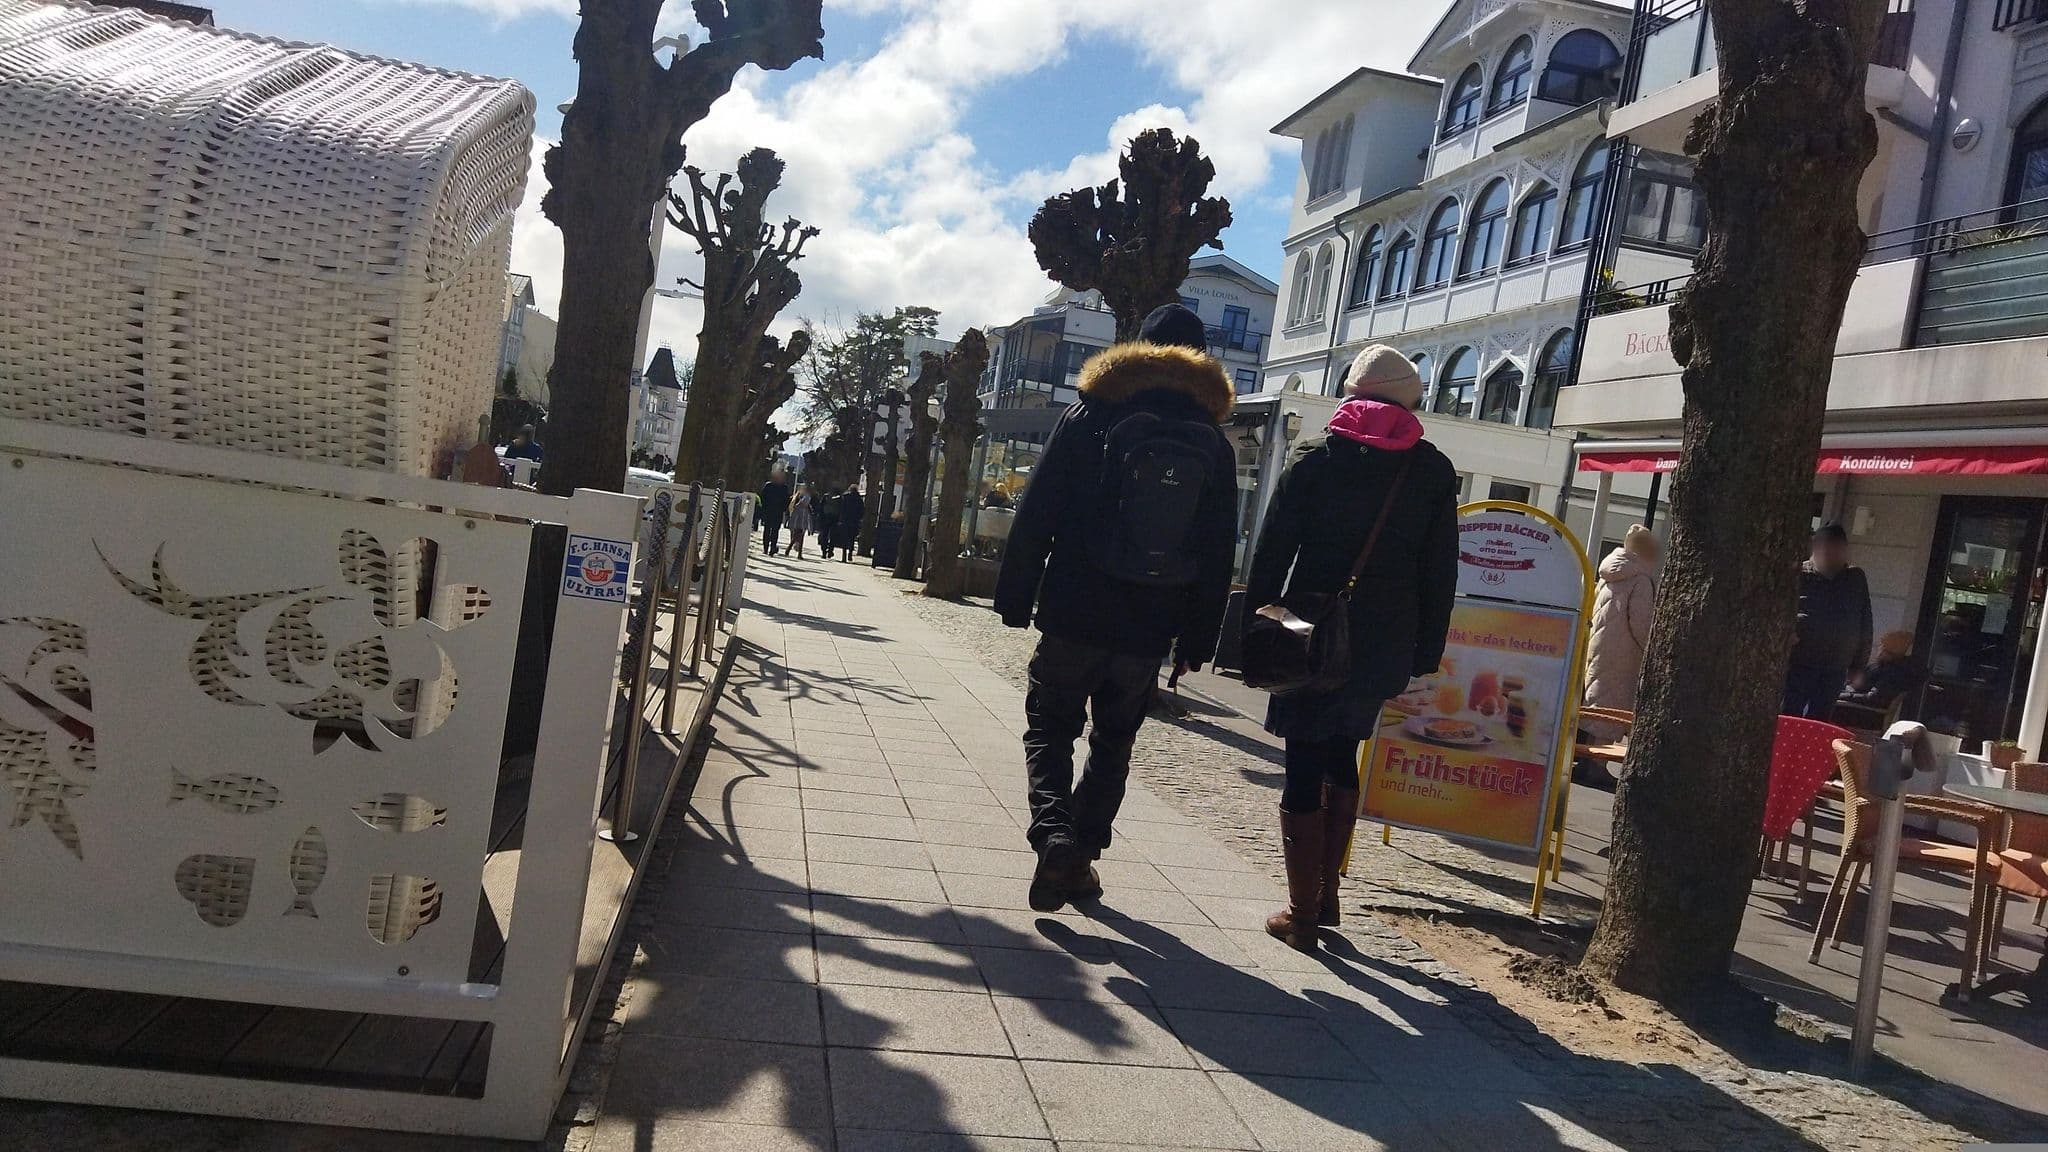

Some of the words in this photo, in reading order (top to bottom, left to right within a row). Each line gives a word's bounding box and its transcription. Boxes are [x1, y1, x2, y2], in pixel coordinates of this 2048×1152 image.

[1188, 285, 1210, 297] VILLA
[1840, 455, 1915, 470] Konditorei
[1504, 523, 1551, 544] BÄCKER
[566, 580, 624, 598] ULTRAS
[1384, 746, 1532, 796] Frühstück
[1381, 778, 1406, 793] und
